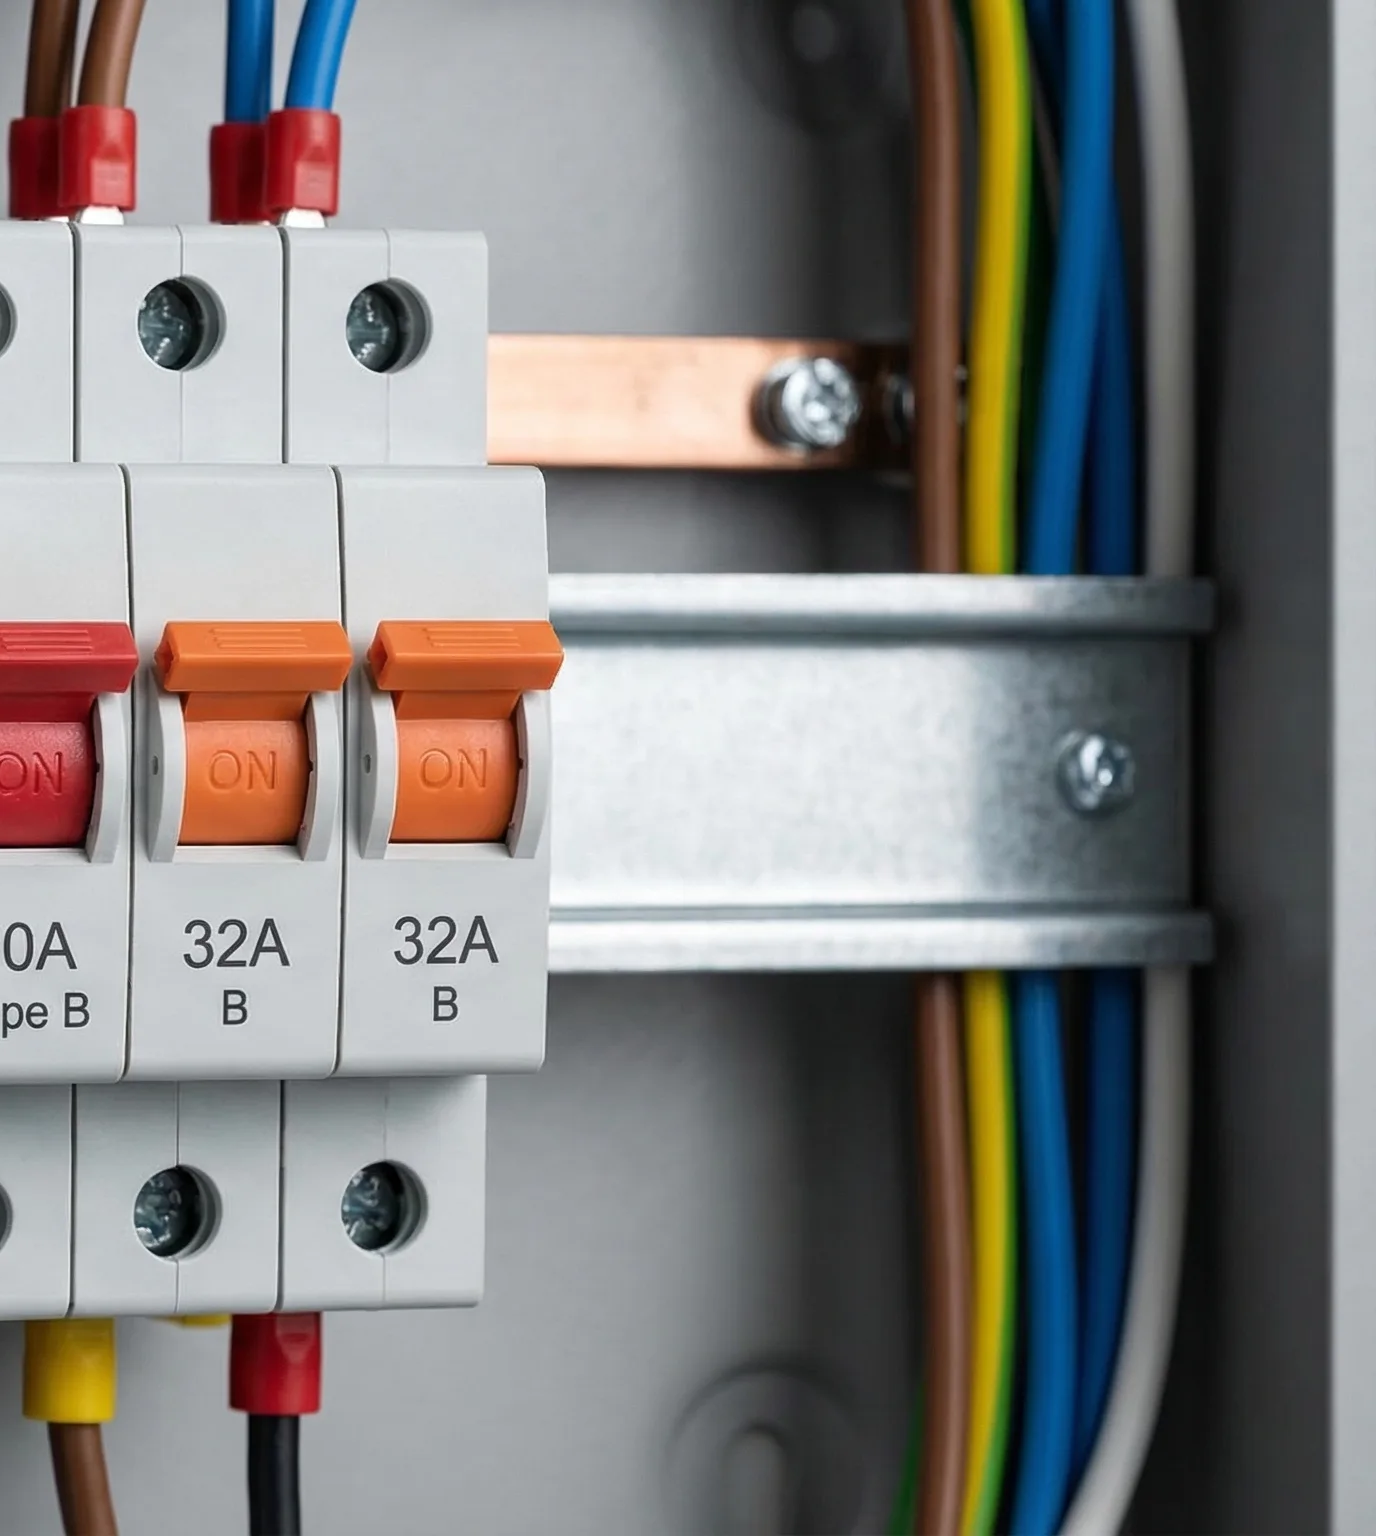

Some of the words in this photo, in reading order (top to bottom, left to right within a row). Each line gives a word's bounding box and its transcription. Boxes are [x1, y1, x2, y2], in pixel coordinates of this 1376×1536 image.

[208, 749, 279, 792] ON
[419, 747, 488, 790] ON
[183, 918, 290, 969] 32A
[393, 915, 499, 966] 32A
[64, 992, 90, 1028] B
[222, 989, 248, 1026] B
[432, 985, 459, 1022] B
